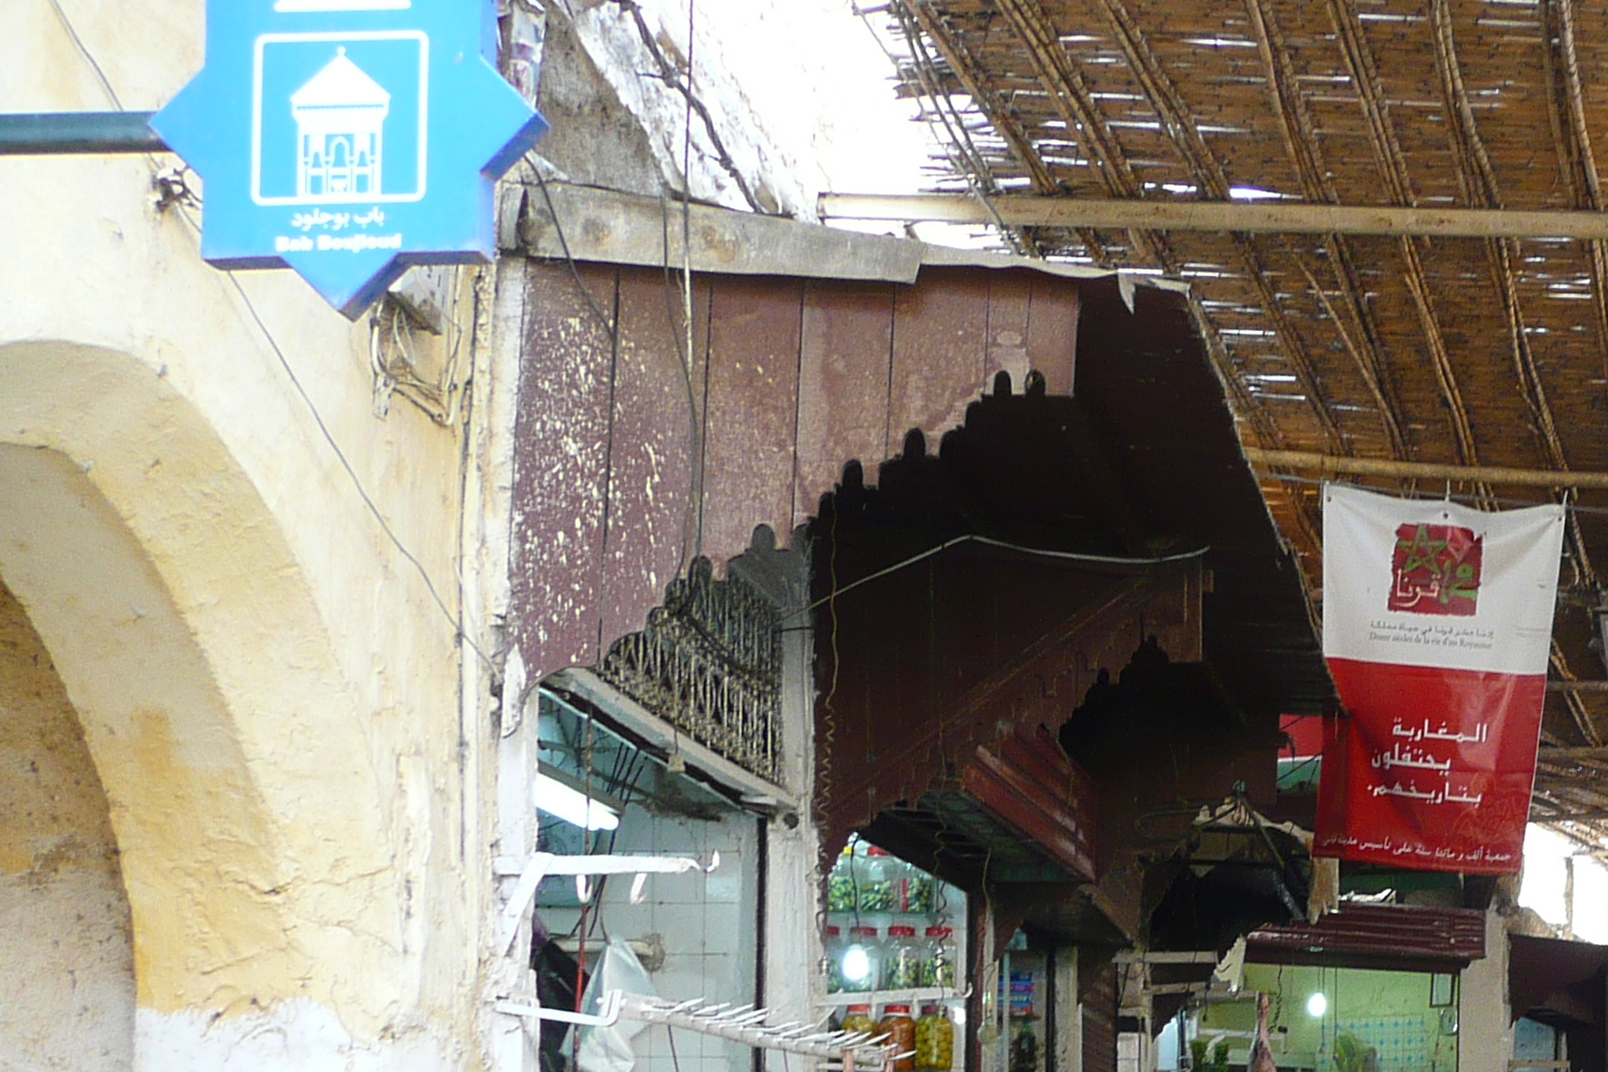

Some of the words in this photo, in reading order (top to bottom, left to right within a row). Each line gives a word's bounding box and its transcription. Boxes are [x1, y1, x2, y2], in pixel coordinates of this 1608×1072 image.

[291, 208, 350, 231] بوجلود
[353, 206, 385, 229] باب
[275, 236, 314, 252] Bab
[317, 233, 402, 253] Boujloud
[1392, 717, 1488, 743] المغاربة
[1371, 742, 1451, 776] يحتفلون
[1392, 842, 1413, 856] على
